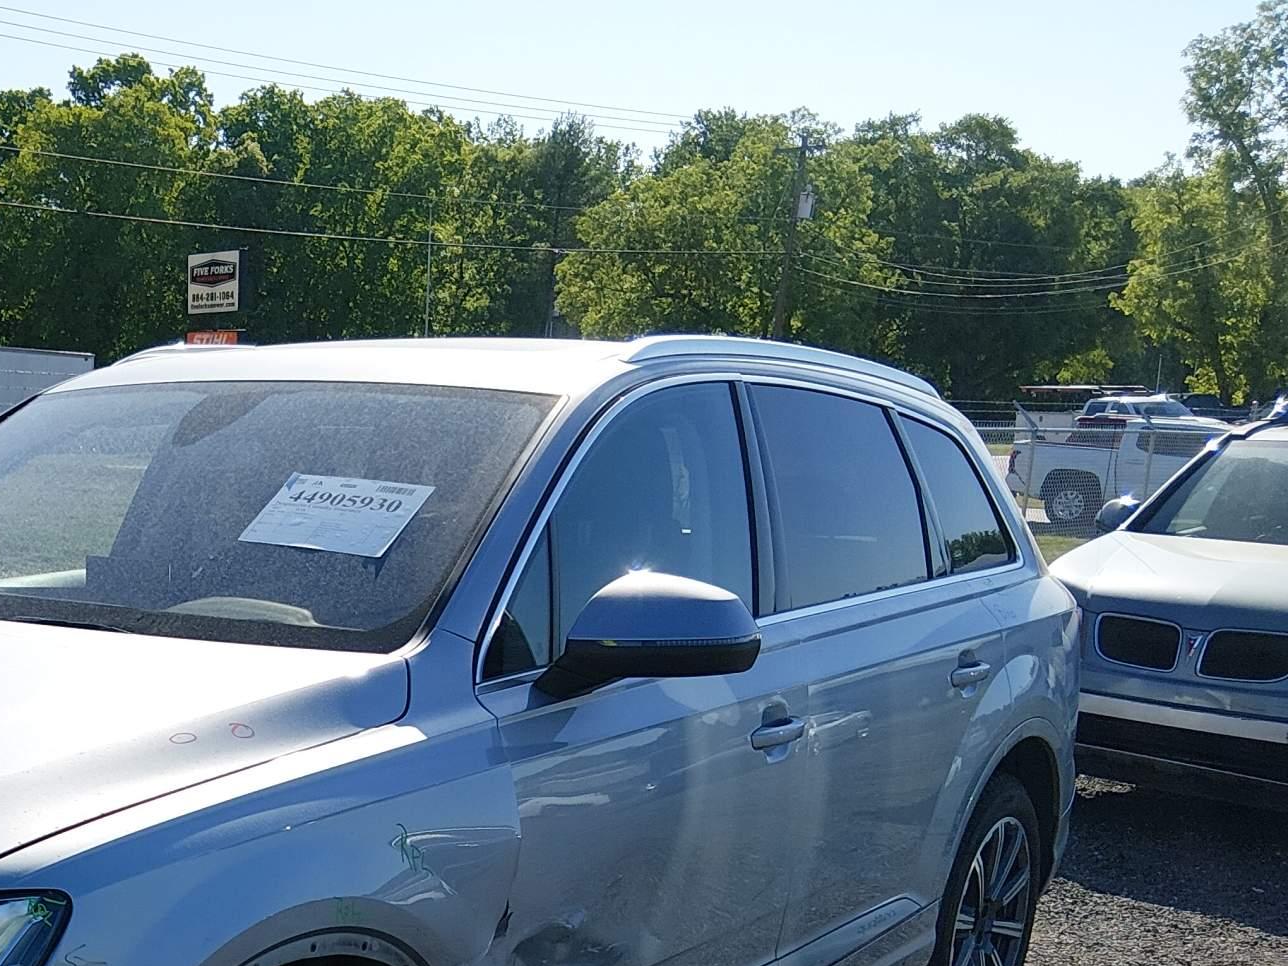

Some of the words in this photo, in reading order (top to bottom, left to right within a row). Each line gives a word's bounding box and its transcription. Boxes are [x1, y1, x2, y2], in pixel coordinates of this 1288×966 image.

[193, 267, 210, 277] FIVE
[210, 265, 234, 275] FORKS
[193, 333, 229, 344] STIHL
[289, 489, 403, 513] 44905930
